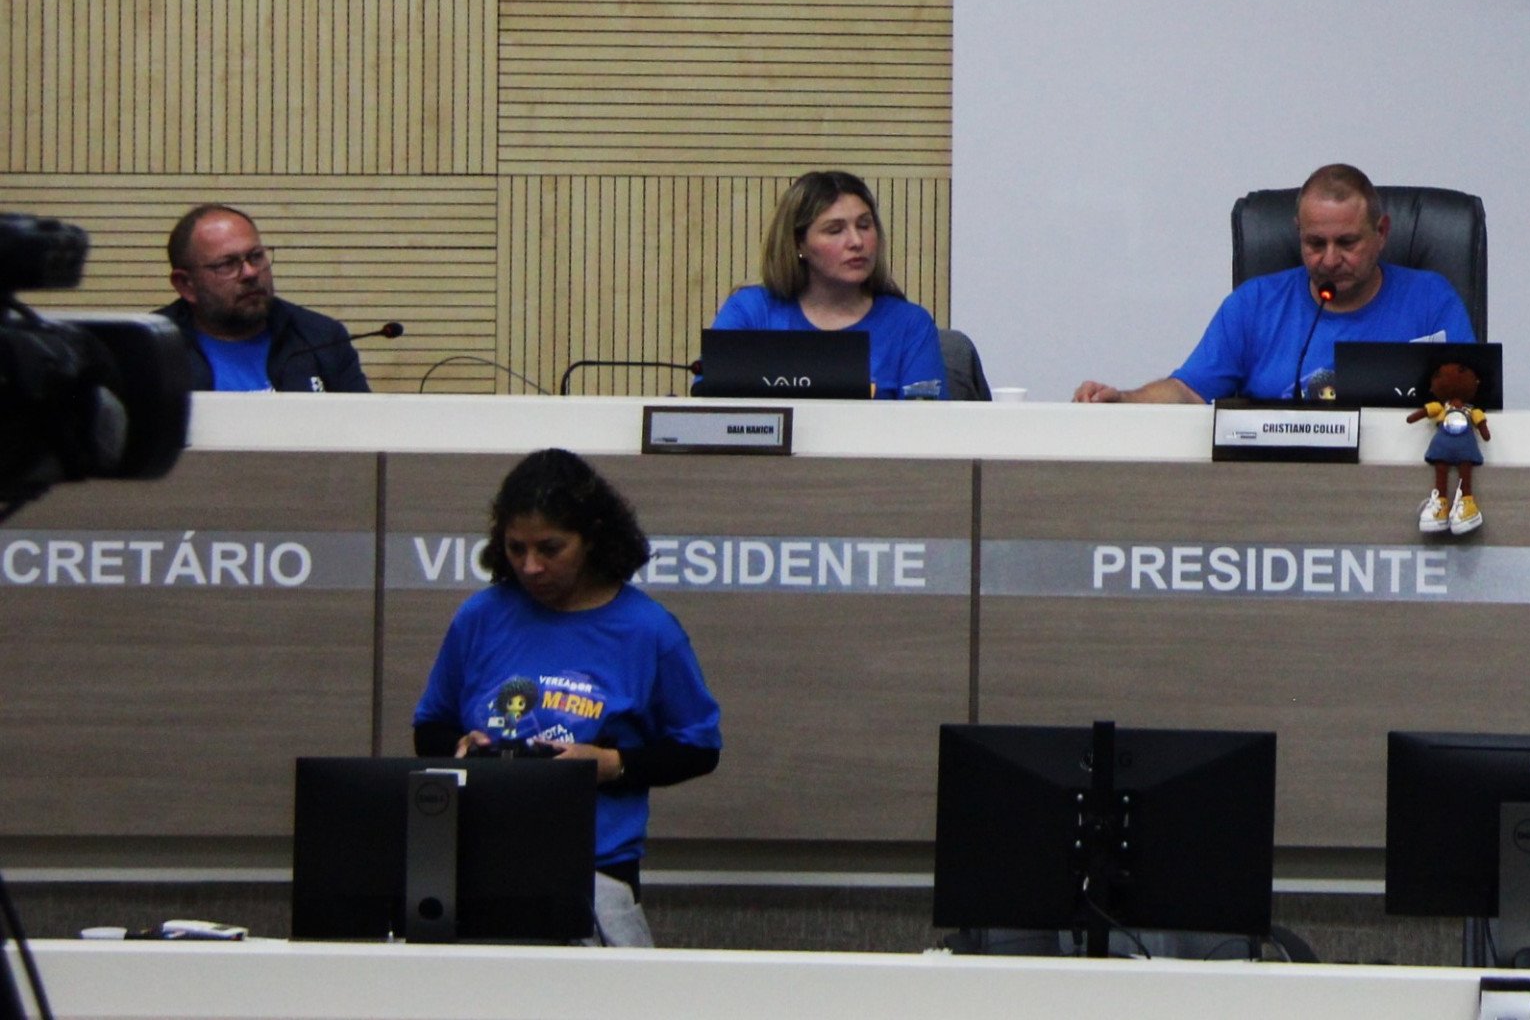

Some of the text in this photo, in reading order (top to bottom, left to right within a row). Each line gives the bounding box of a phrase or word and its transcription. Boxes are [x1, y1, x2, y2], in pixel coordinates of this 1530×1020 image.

[726, 425, 774, 434] DAIA HANICH
[1262, 423, 1346, 435] CRISTIANO COLLER
[414, 537, 926, 587] VIC ESIDENTE
[1093, 545, 1448, 594] PRESIDENTE
